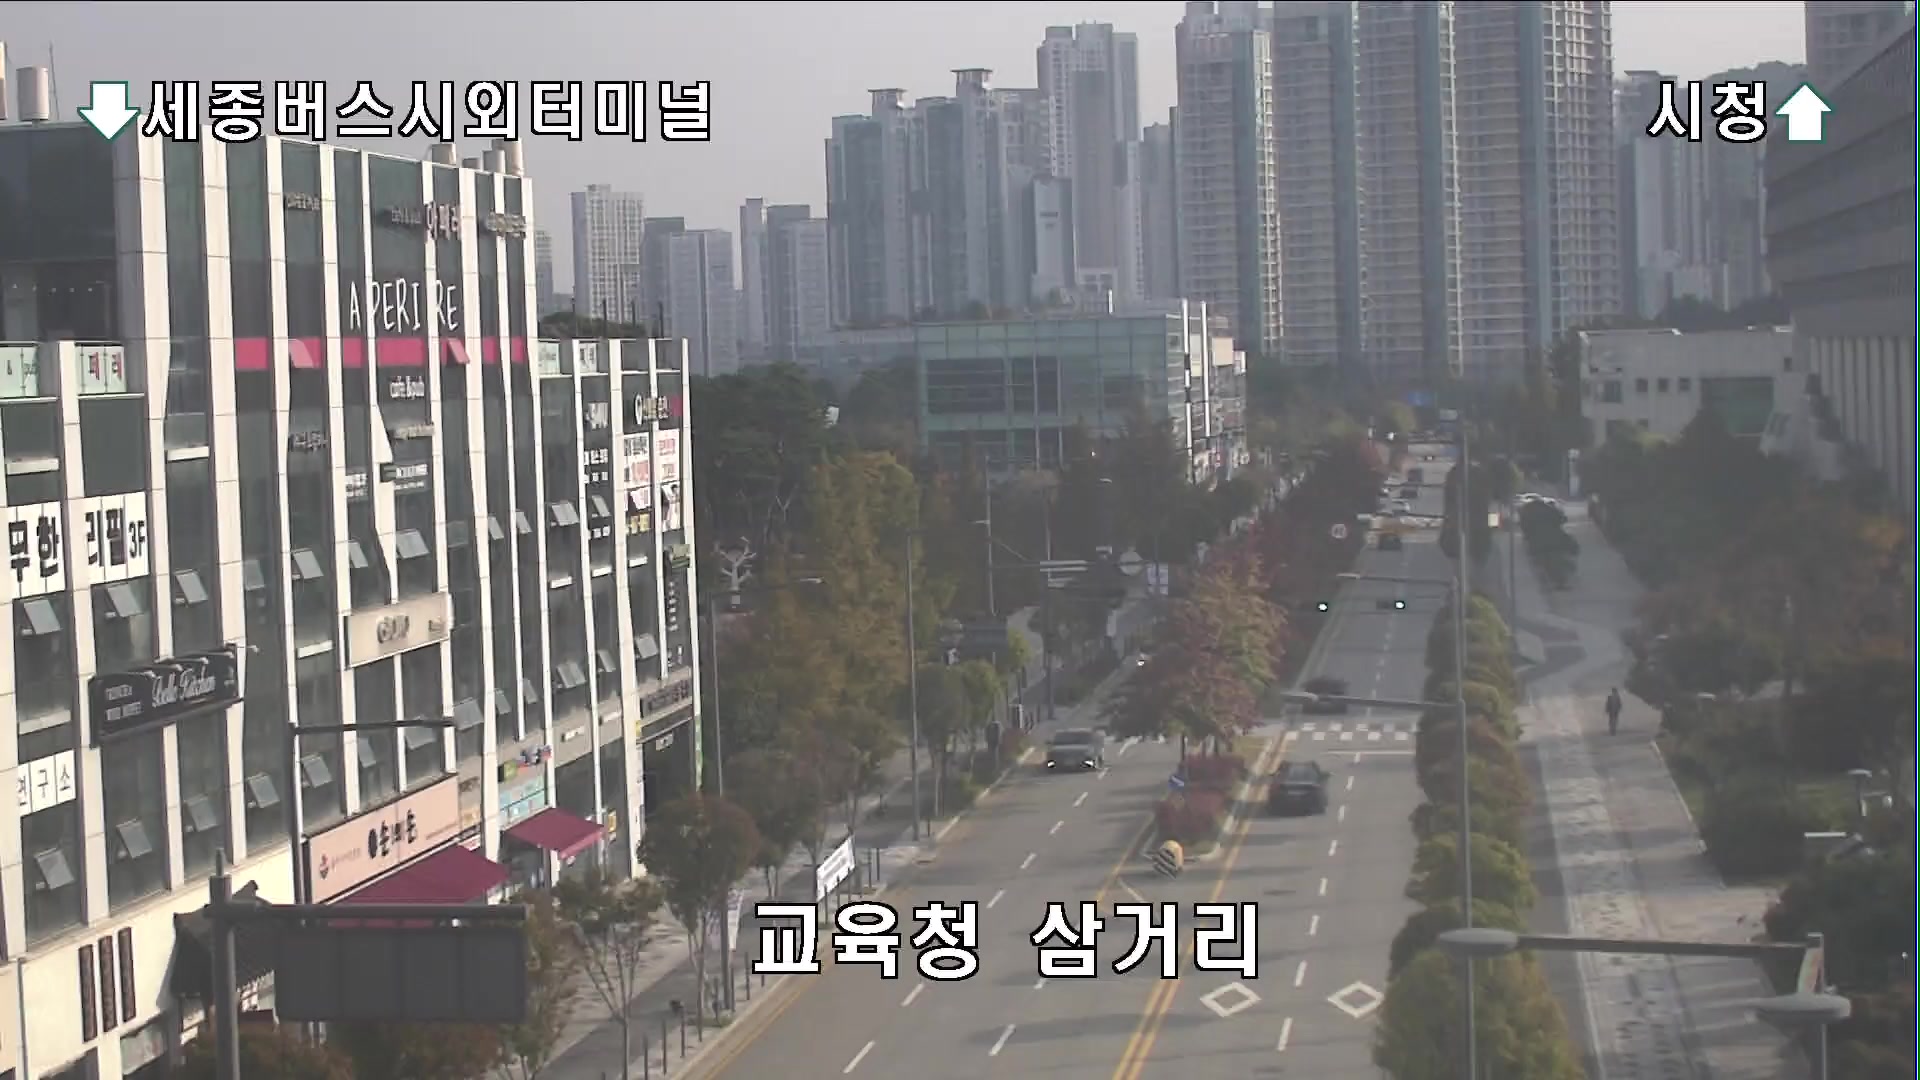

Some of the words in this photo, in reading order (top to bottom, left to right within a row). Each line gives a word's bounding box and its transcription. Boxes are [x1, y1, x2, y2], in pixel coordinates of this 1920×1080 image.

[9, 515, 60, 583] 무한
[85, 507, 127, 568] 리필
[128, 519, 146, 558] 3F
